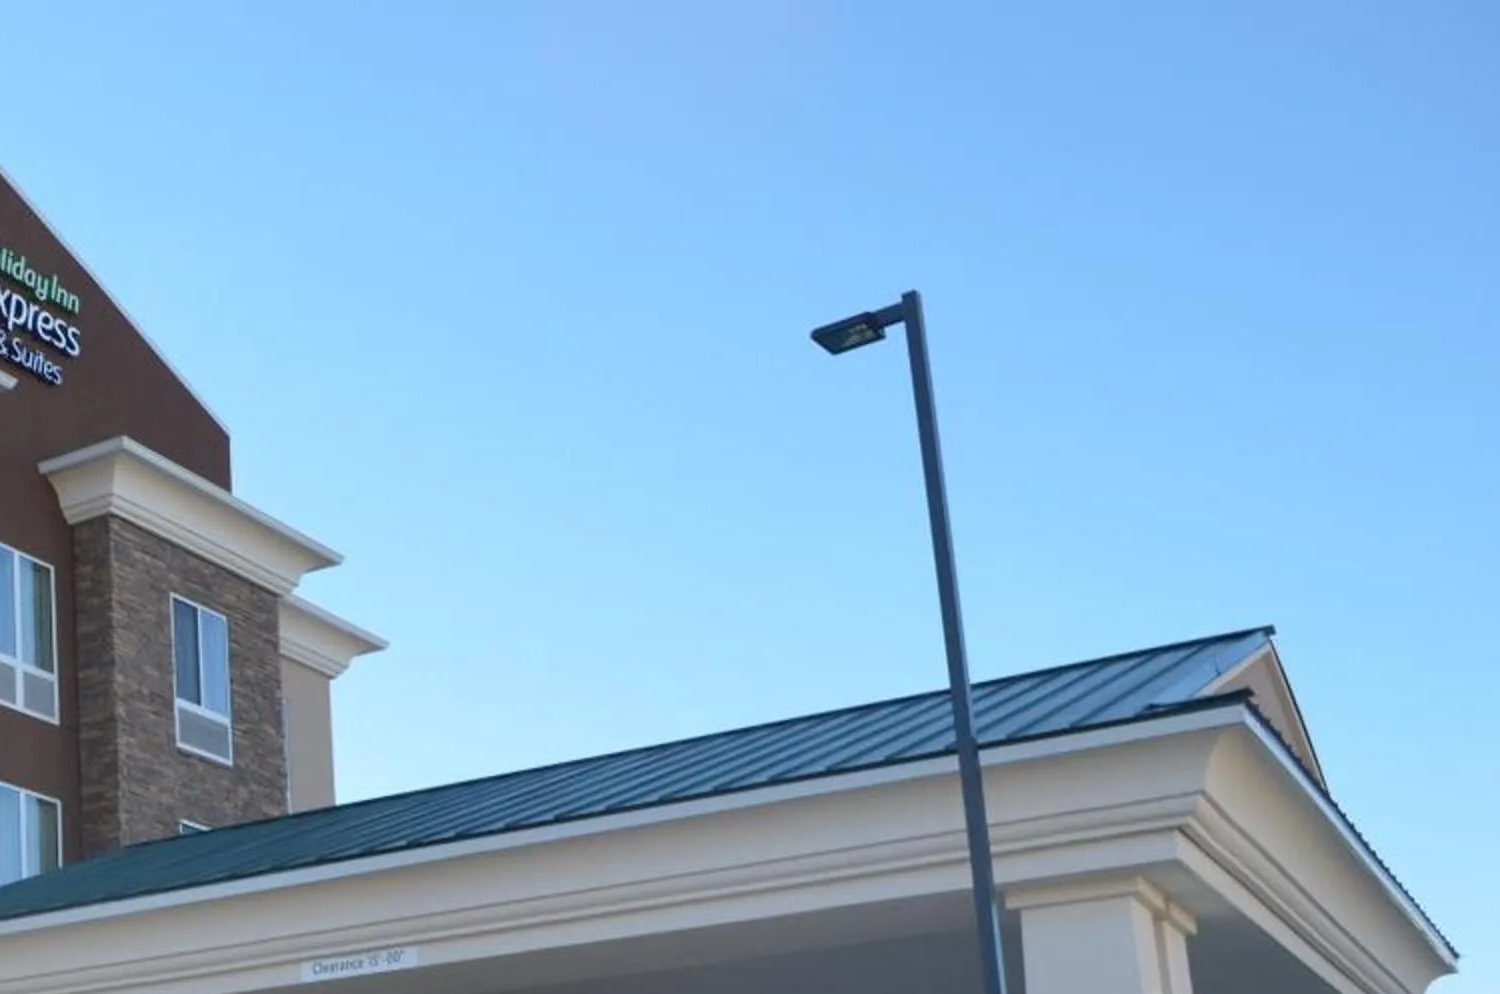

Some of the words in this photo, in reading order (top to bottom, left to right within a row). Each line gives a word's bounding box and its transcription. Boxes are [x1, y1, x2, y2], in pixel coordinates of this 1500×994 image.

[51, 274, 80, 315] Inn
[11, 337, 63, 385] Suites
[312, 957, 364, 975] Clearance
